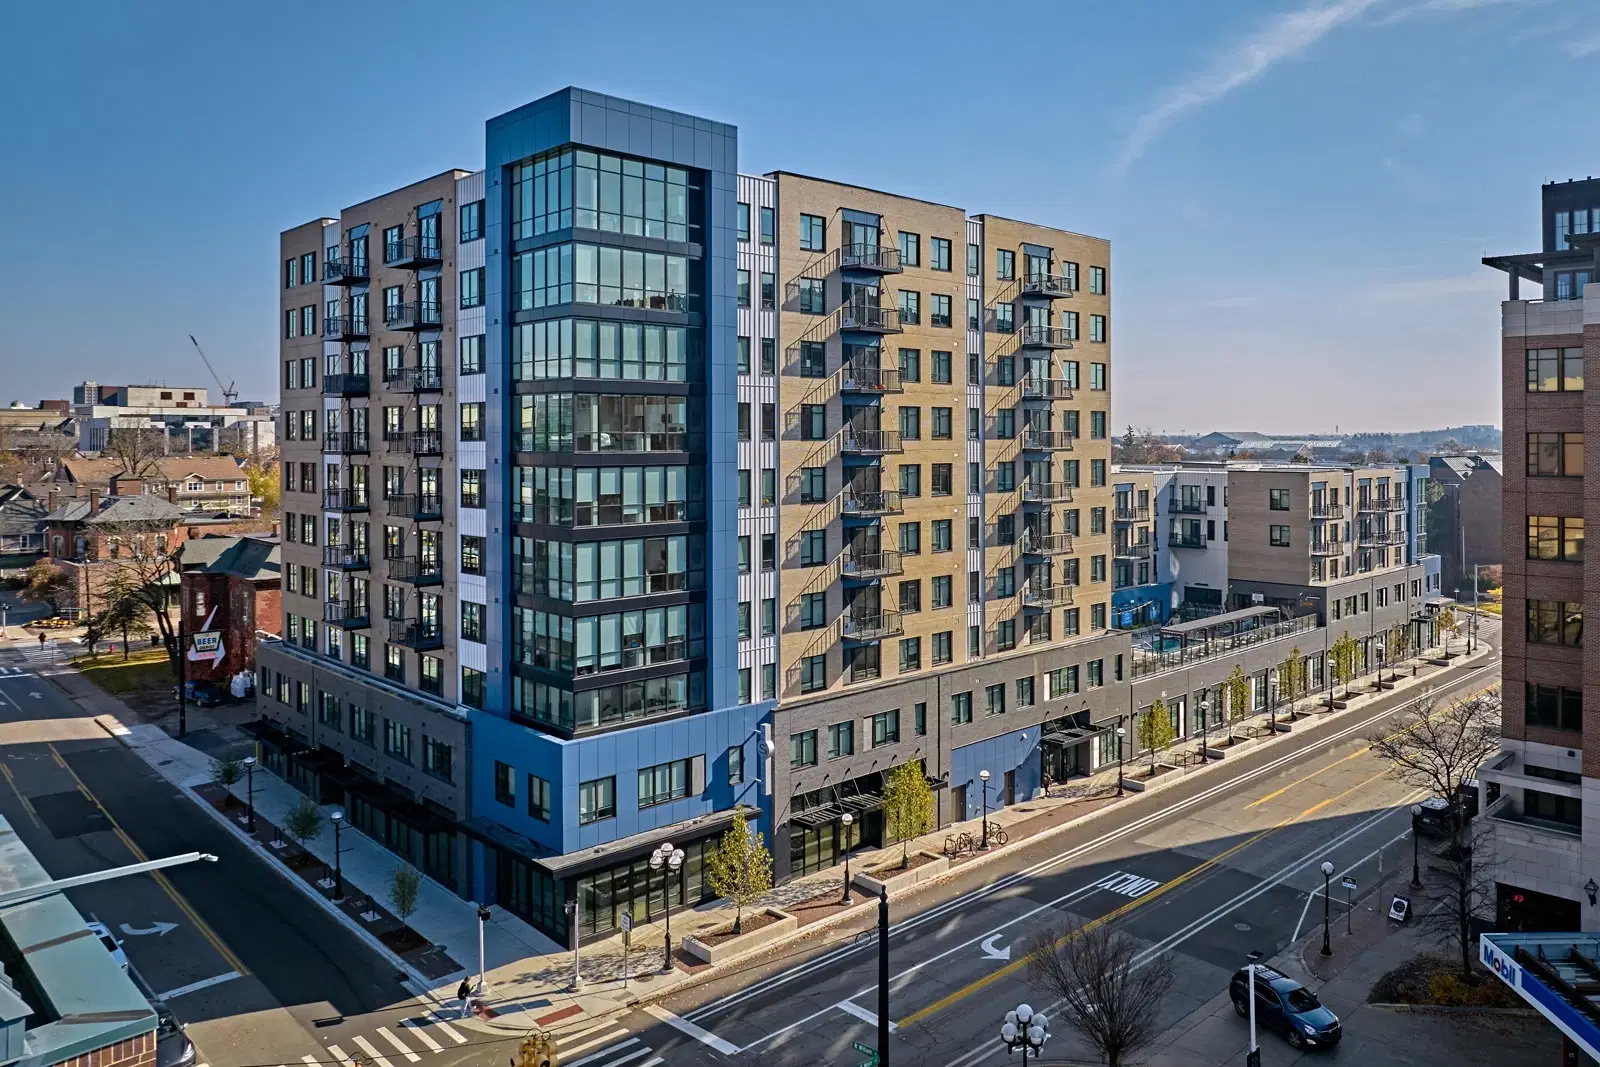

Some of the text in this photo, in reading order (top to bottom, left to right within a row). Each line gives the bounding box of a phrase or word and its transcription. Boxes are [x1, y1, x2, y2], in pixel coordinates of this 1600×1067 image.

[197, 637, 217, 646] BEER
[1096, 873, 1160, 897] ONLY
[1483, 943, 1516, 987] Mobil
